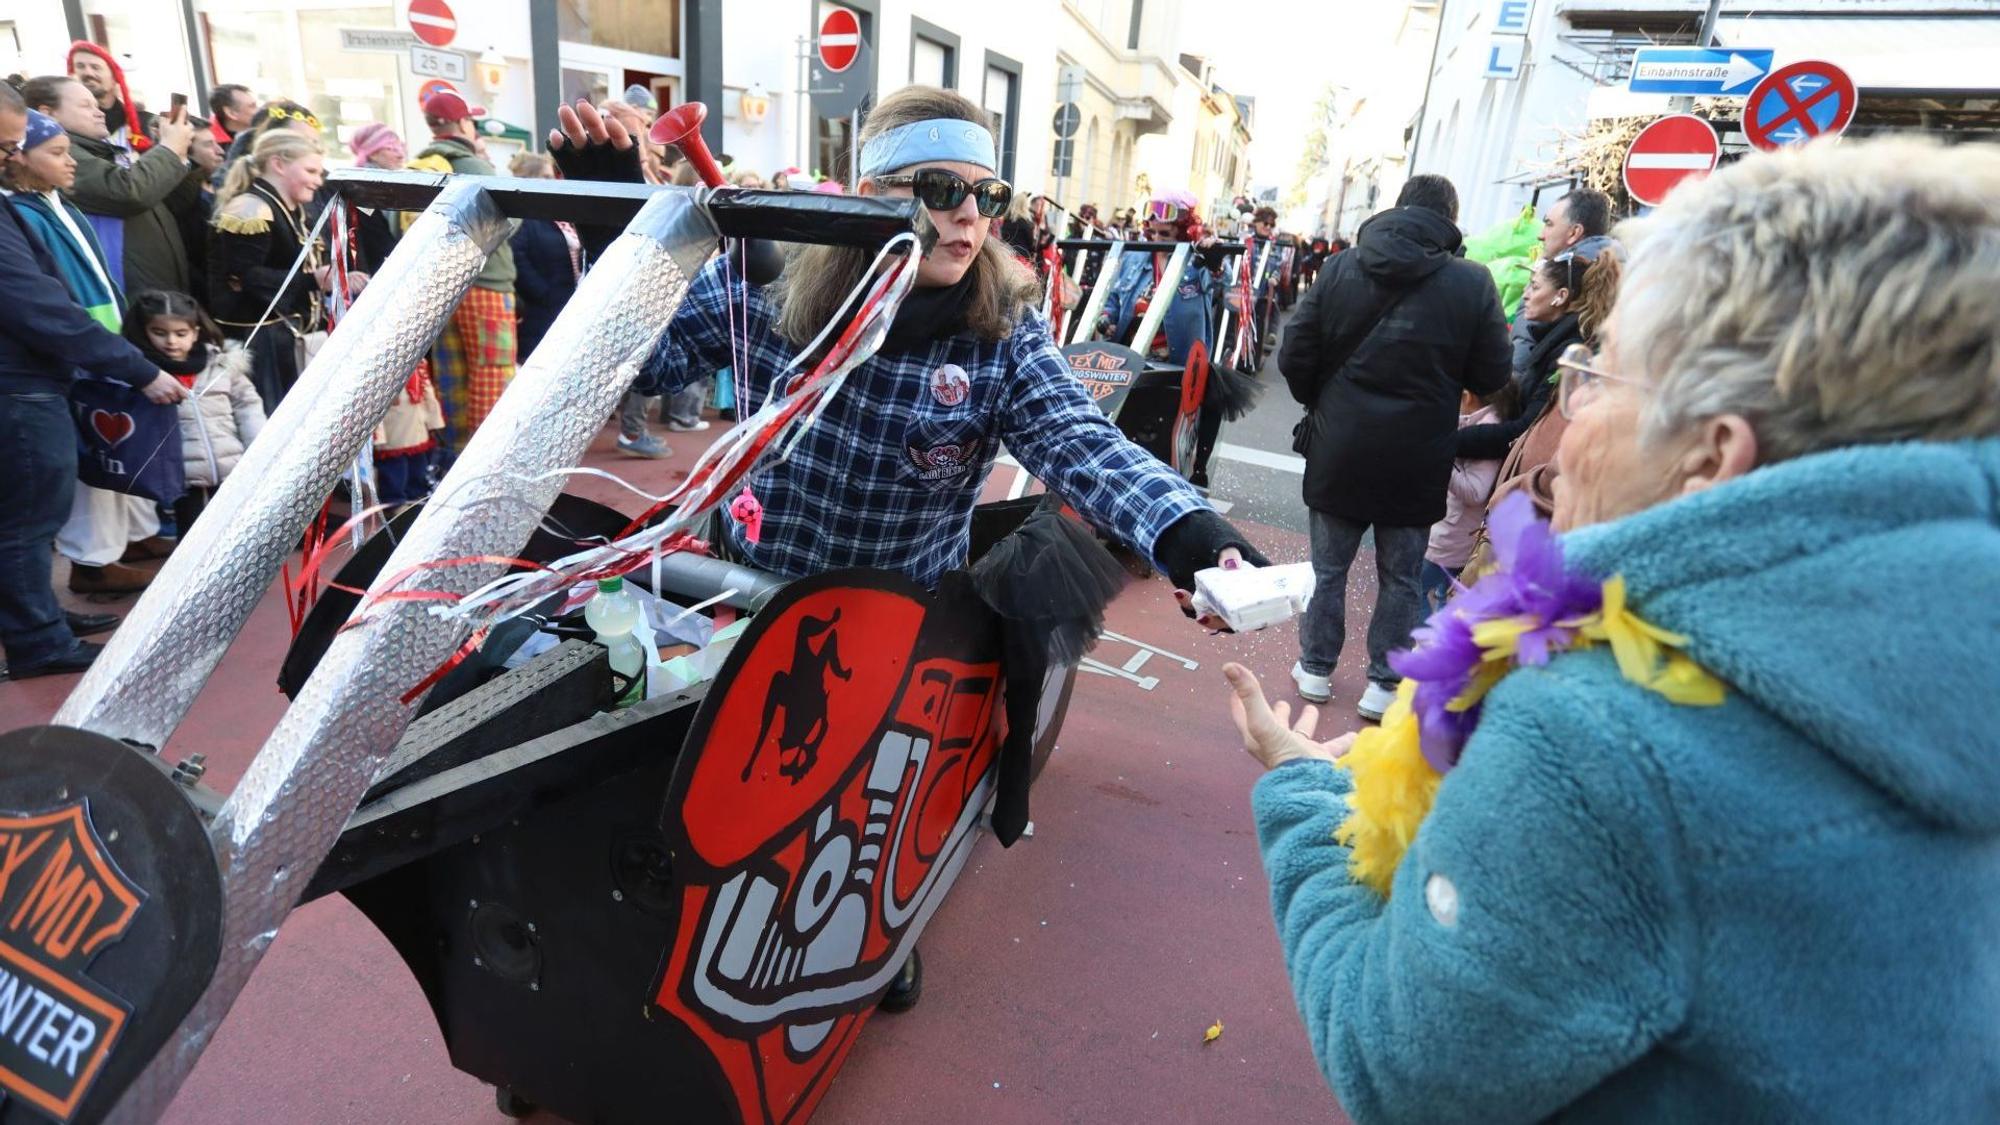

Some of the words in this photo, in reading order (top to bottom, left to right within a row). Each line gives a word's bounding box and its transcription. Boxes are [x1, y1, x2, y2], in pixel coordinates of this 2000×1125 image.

[421, 54, 438, 70] 25
[445, 62, 457, 73] m
[1639, 65, 1729, 78] Einbahnstraße
